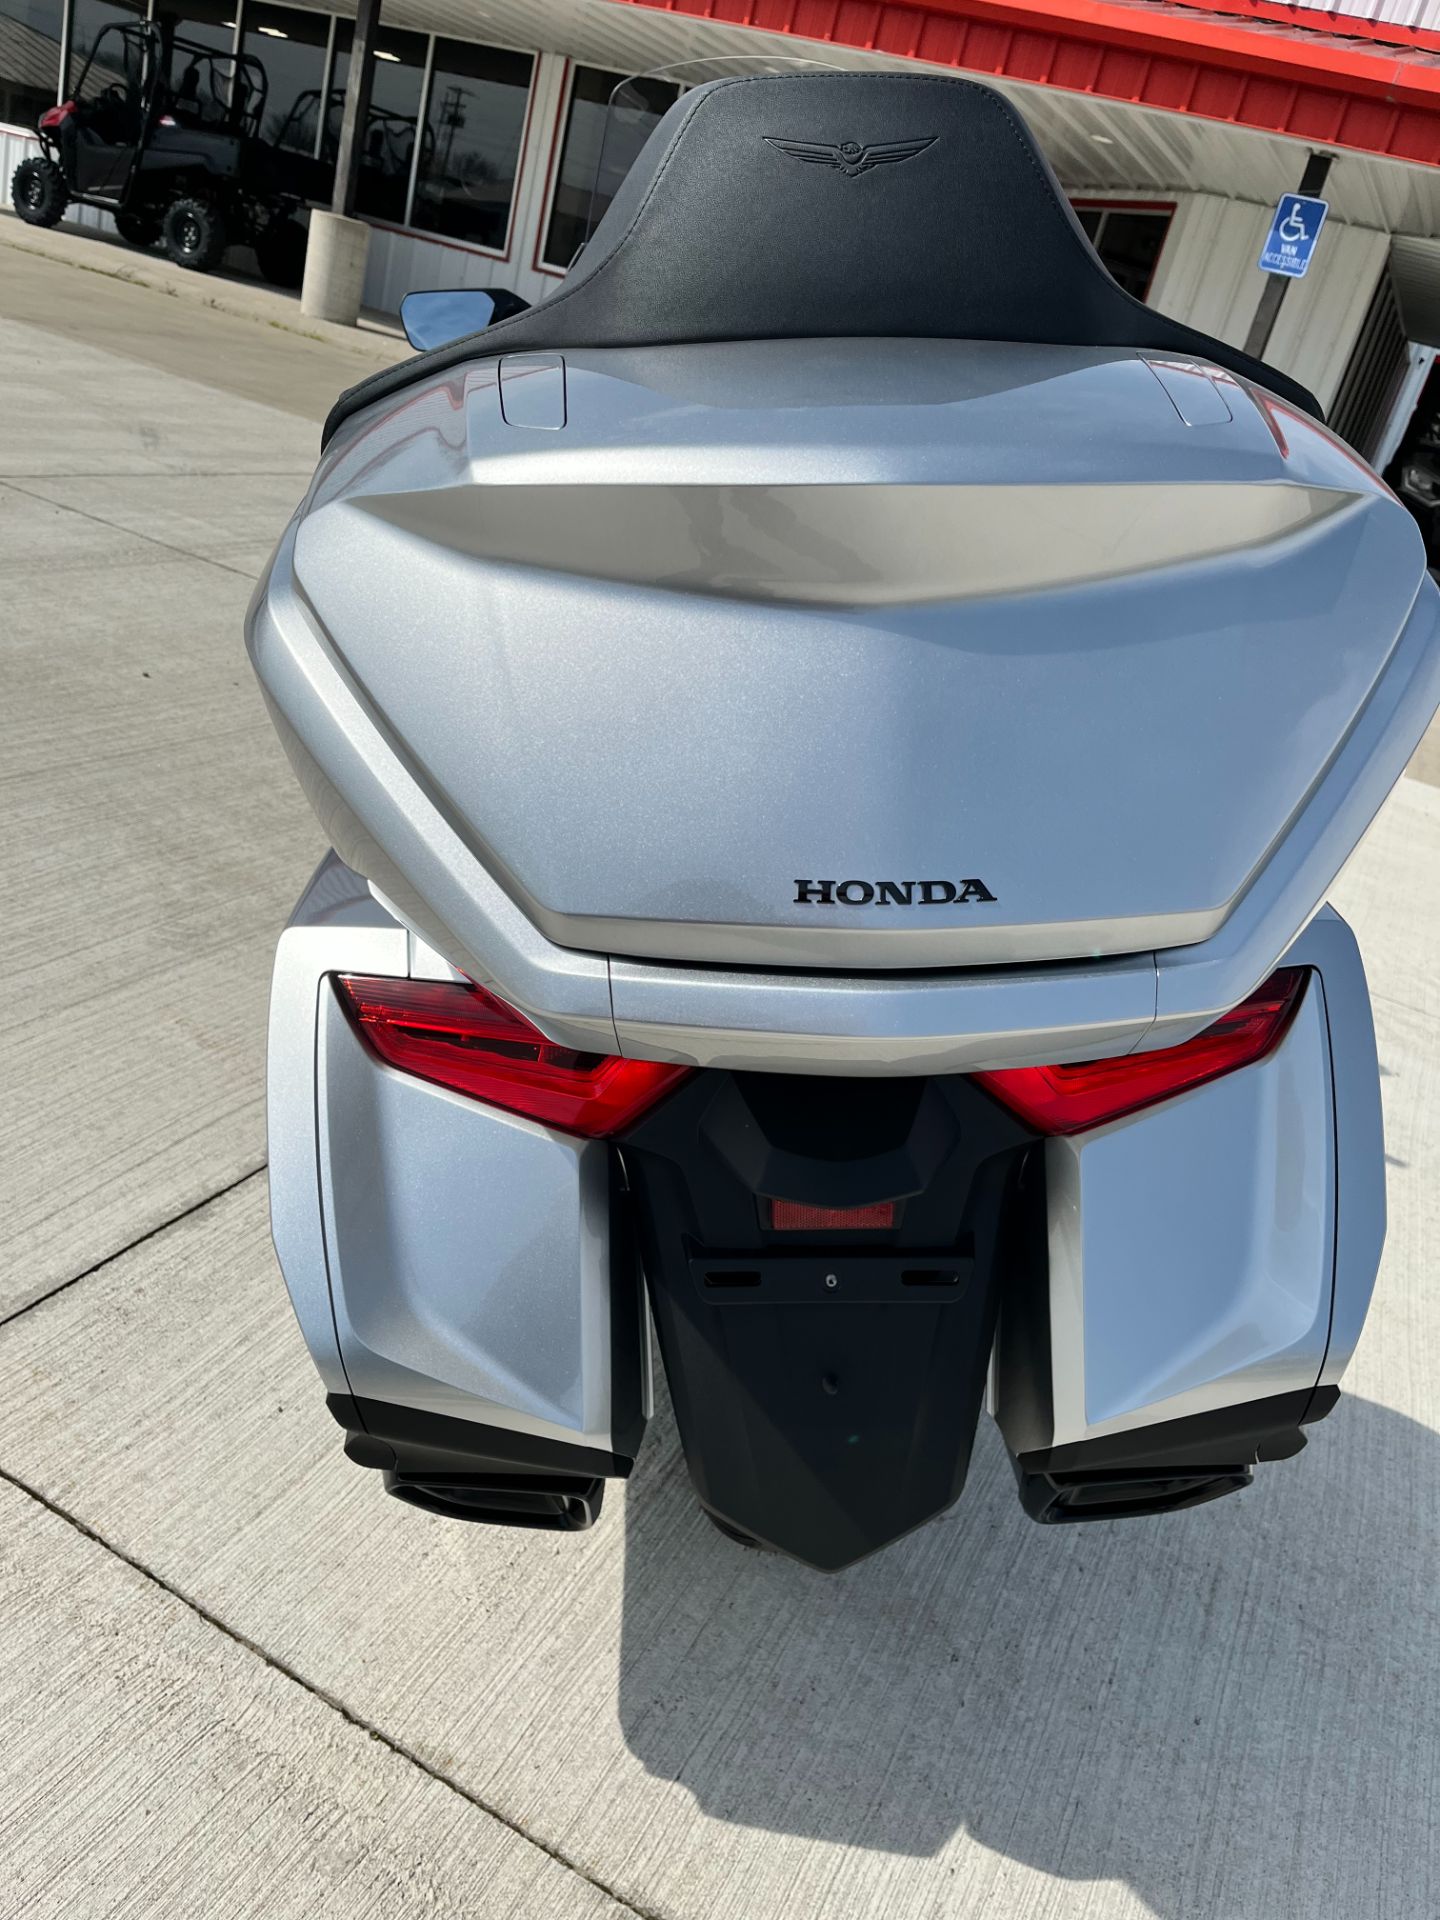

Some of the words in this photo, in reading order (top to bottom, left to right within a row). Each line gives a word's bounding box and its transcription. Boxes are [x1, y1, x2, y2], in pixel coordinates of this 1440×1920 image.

[1280, 243, 1298, 256] VAN
[1264, 252, 1307, 270] ACCESSIBLE
[793, 878, 998, 905] HONDA
